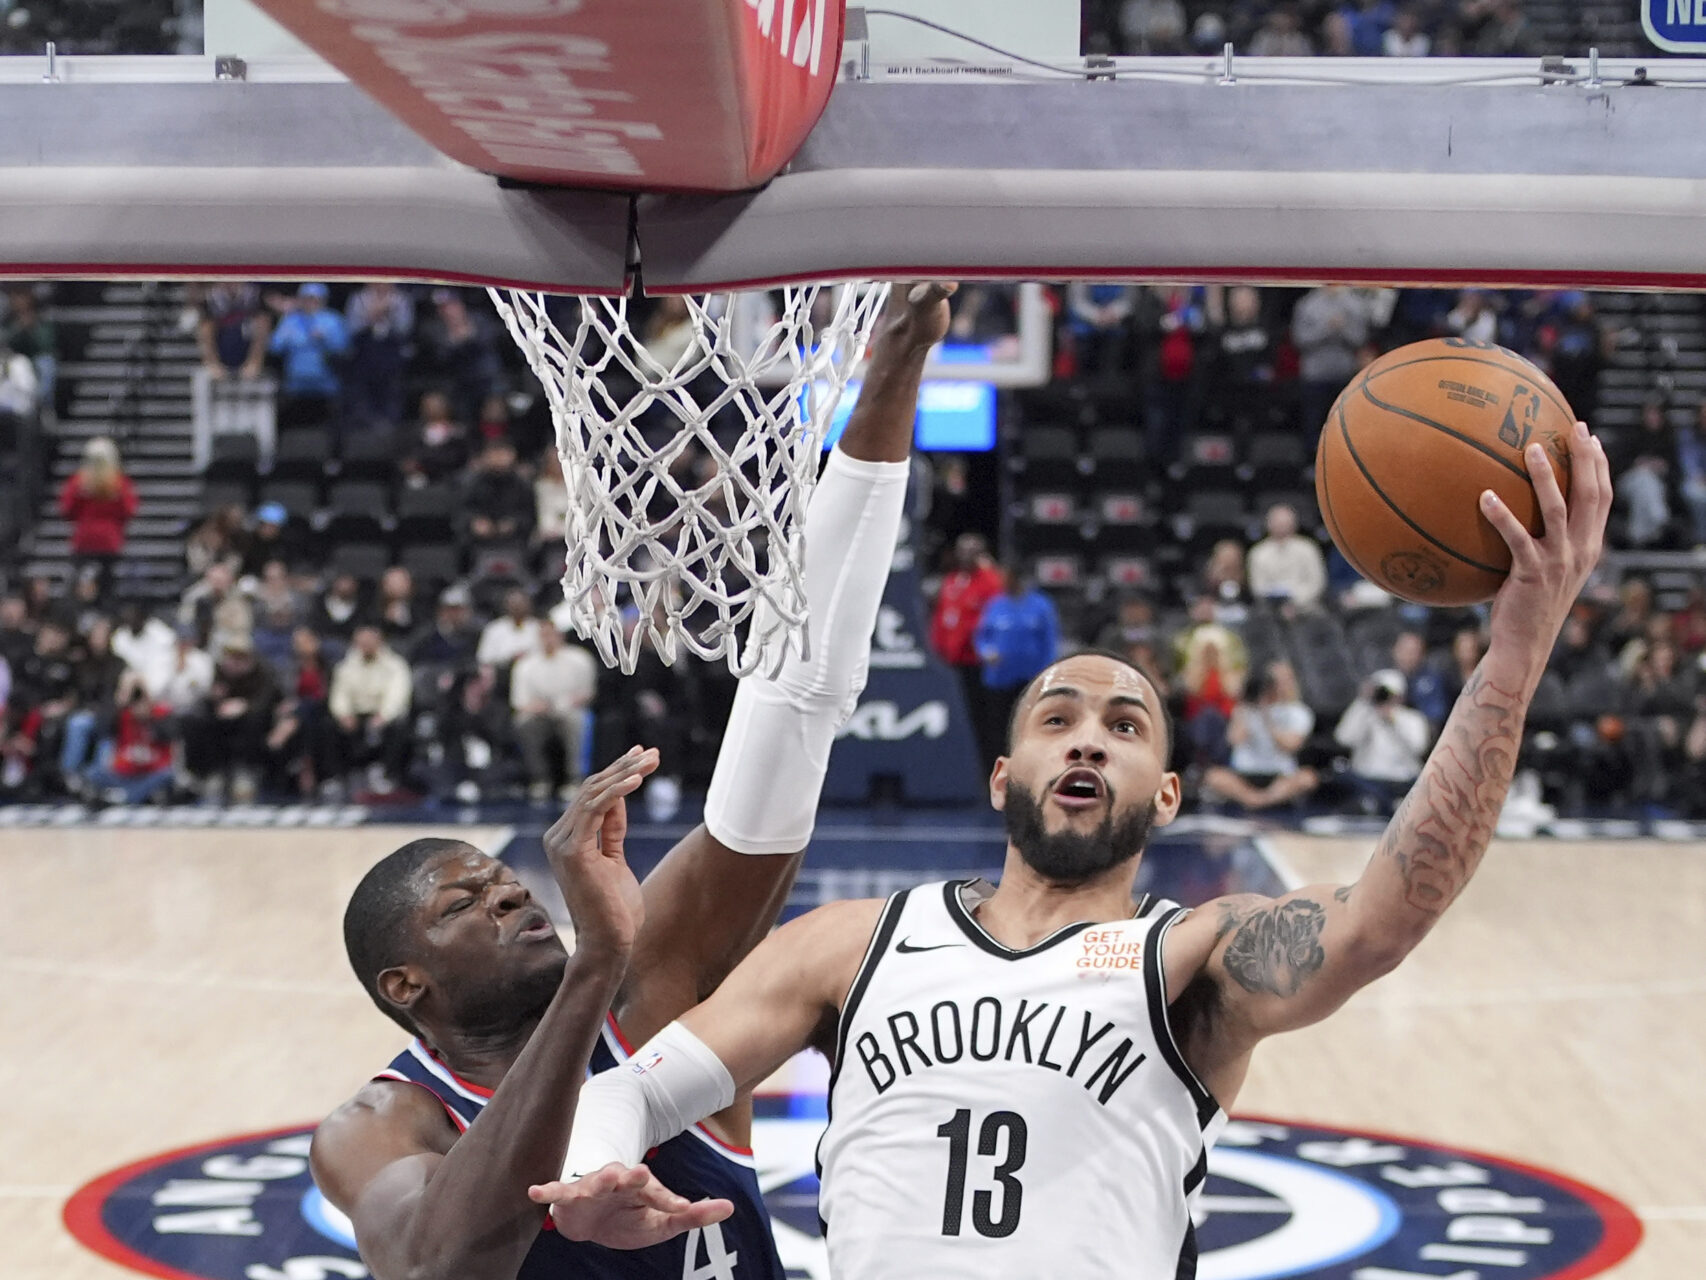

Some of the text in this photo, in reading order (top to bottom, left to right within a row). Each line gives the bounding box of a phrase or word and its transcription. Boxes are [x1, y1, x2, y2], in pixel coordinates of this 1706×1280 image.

[1084, 930, 1124, 943] GET
[1083, 942, 1141, 956] YOUR
[1076, 956, 1142, 970] GUIDE
[855, 996, 1147, 1106] BROOKLYN
[937, 1108, 1028, 1239] 13
